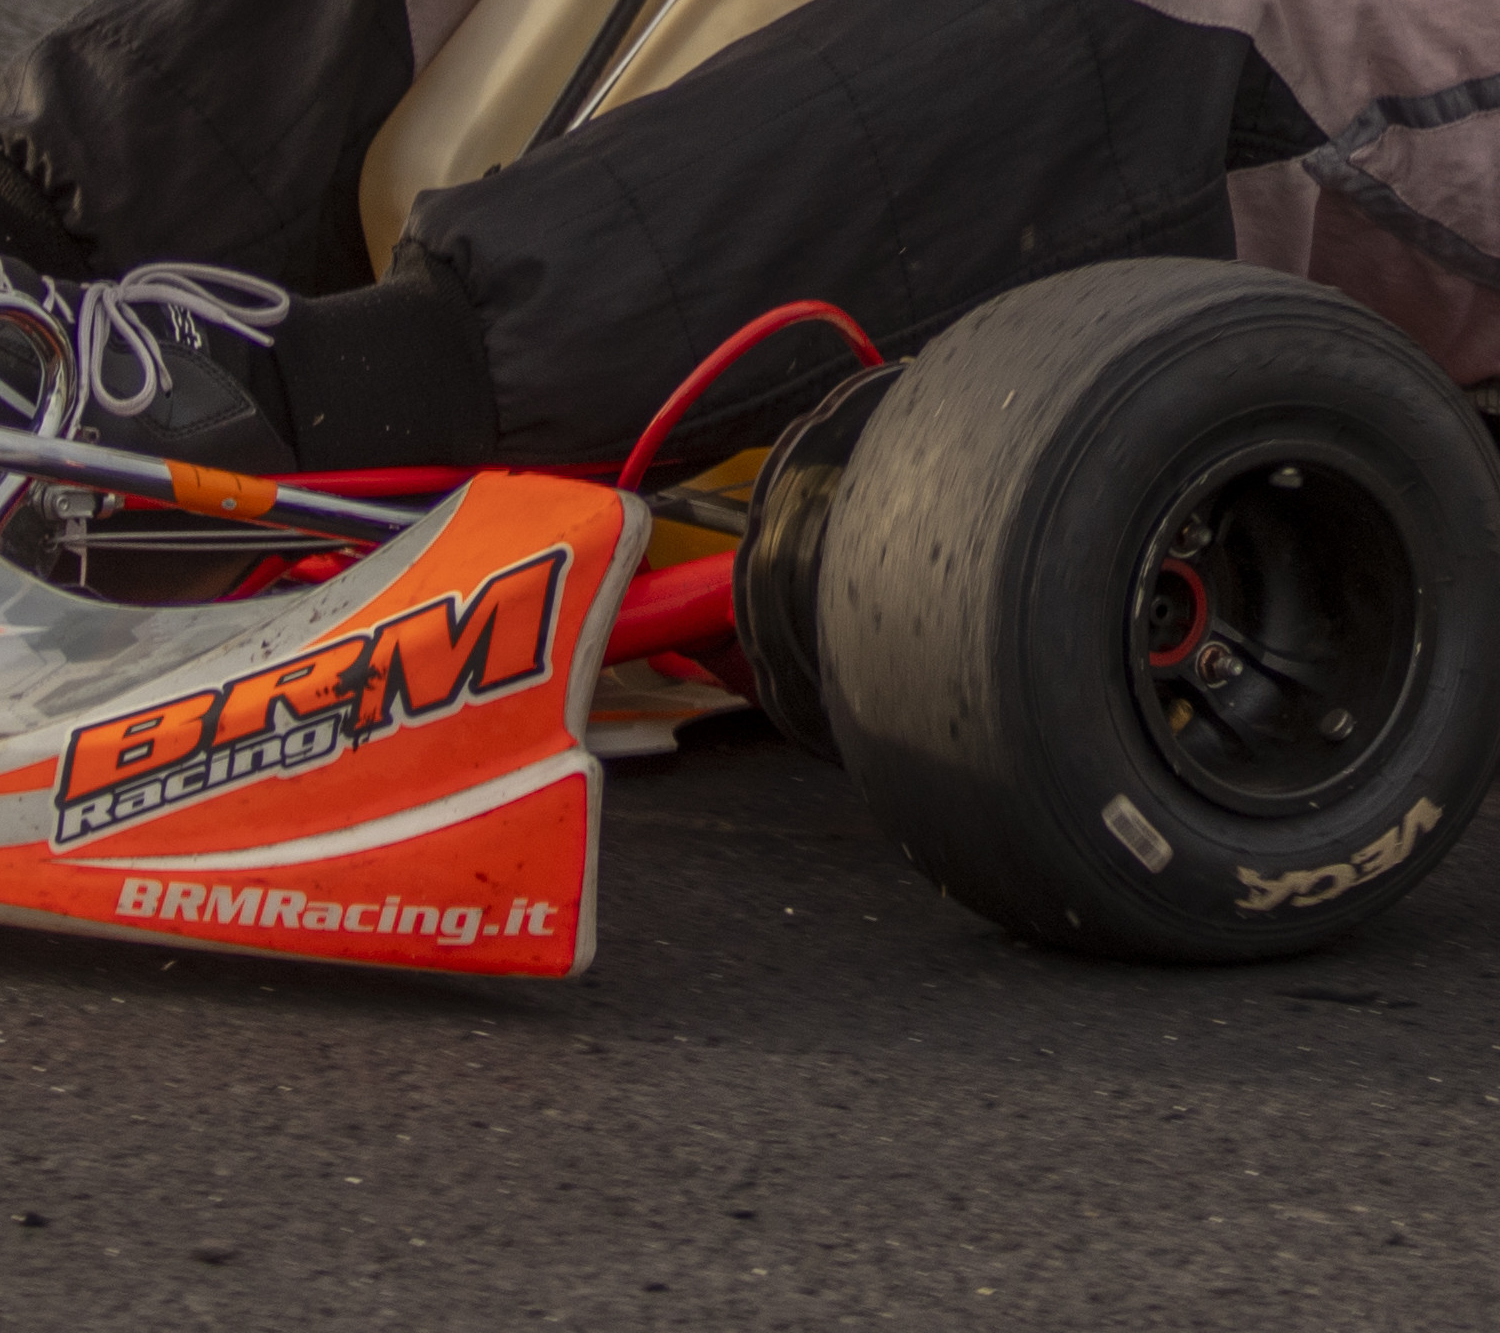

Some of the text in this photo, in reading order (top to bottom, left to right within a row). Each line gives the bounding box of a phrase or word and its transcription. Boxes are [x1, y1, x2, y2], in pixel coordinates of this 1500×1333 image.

[62, 545, 569, 802] BRM
[55, 714, 347, 844] Racing
[115, 878, 560, 945] BRMRacing.it
